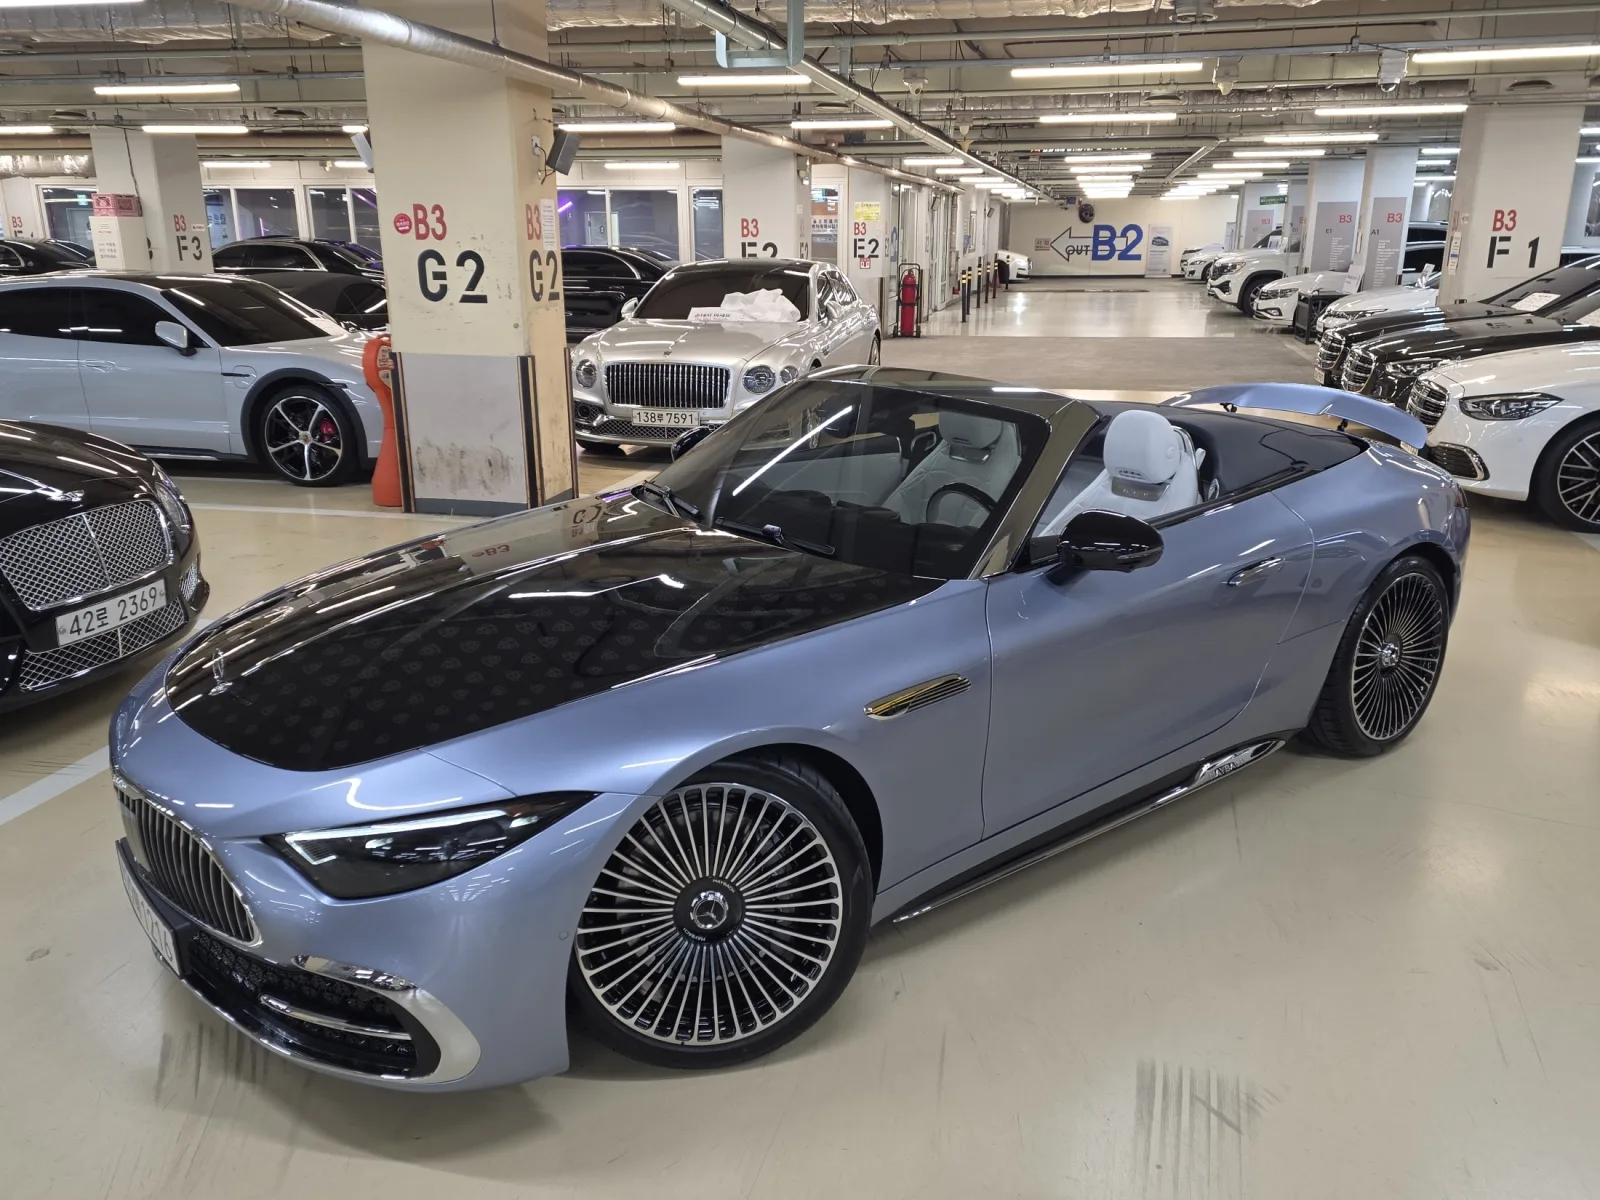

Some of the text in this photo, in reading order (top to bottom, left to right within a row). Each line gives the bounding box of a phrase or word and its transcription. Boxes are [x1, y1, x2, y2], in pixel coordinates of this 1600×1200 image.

[11, 216, 23, 228] B3
[173, 214, 187, 232] B3
[413, 204, 447, 240] B3
[525, 204, 541, 240] B3
[741, 218, 759, 238] B3
[853, 222, 867, 236] B3
[1339, 215, 1352, 223] B3
[1387, 213, 1403, 223] B3
[1492, 209, 1517, 232] B3
[176, 235, 203, 261] F3
[853, 238, 880, 259] E2
[1065, 245, 1090, 256] OUT
[1091, 224, 1144, 261] B2
[417, 249, 488, 304] G2
[529, 249, 560, 302] G2
[665, 412, 693, 424] 7591
[69, 586, 157, 636] 42로 2369
